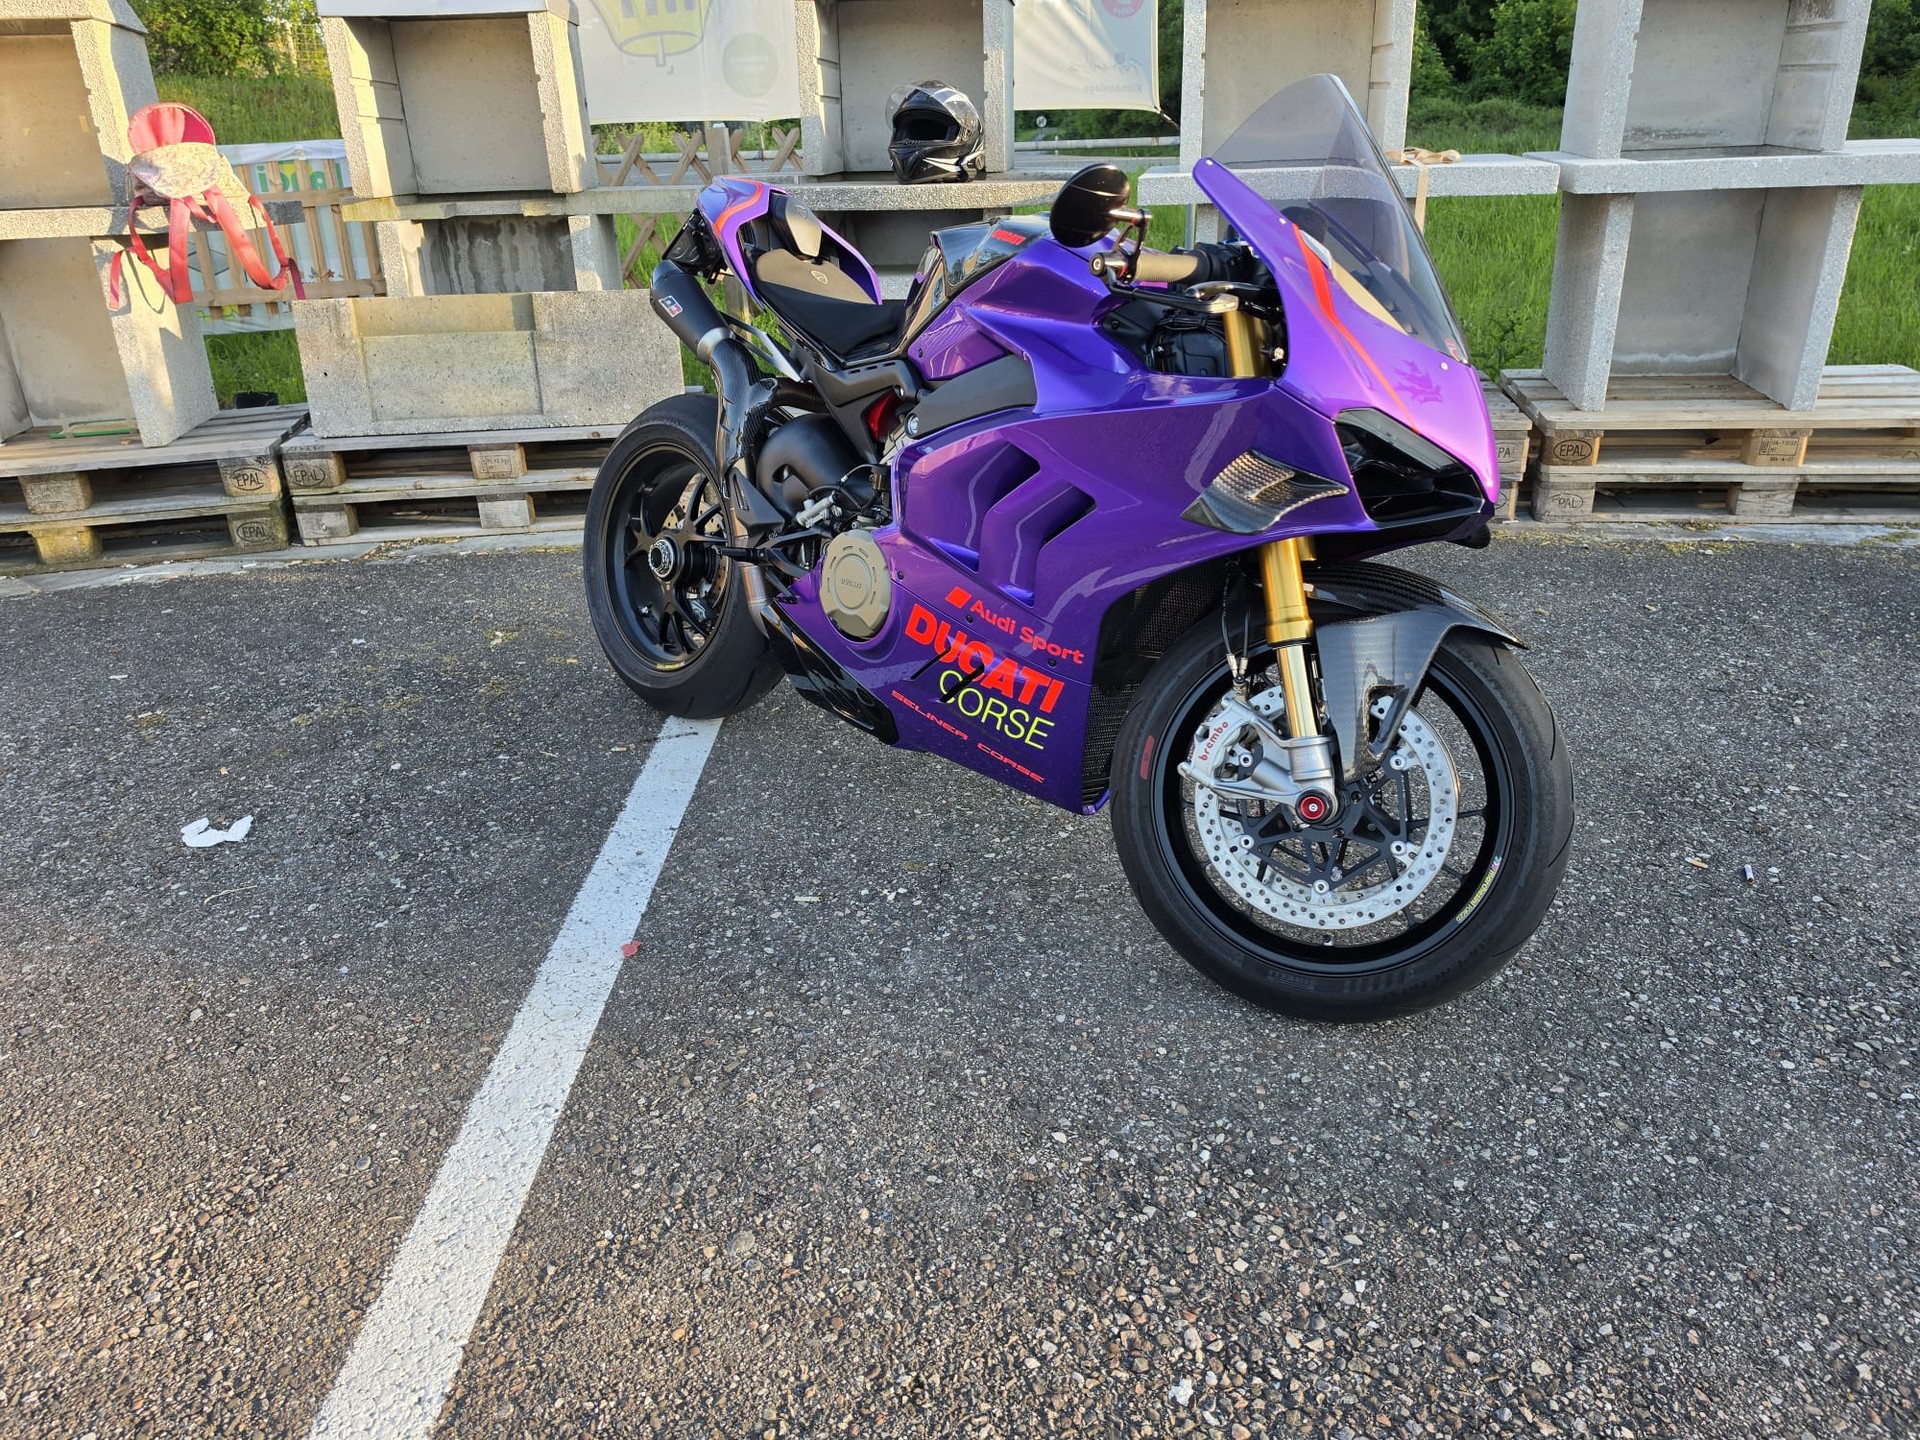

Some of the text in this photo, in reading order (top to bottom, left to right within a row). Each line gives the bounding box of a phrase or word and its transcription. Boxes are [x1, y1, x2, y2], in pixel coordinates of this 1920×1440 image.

[1559, 444, 1586, 457] EPAL
[236, 473, 261, 487] EPAL
[242, 525, 268, 539] EPAL
[970, 600, 1085, 664] Audi Sport
[905, 603, 1065, 713] DUCATI
[939, 670, 1055, 750] CORSE
[1198, 721, 1229, 761] brembo
[977, 742, 1045, 783] CORSE
